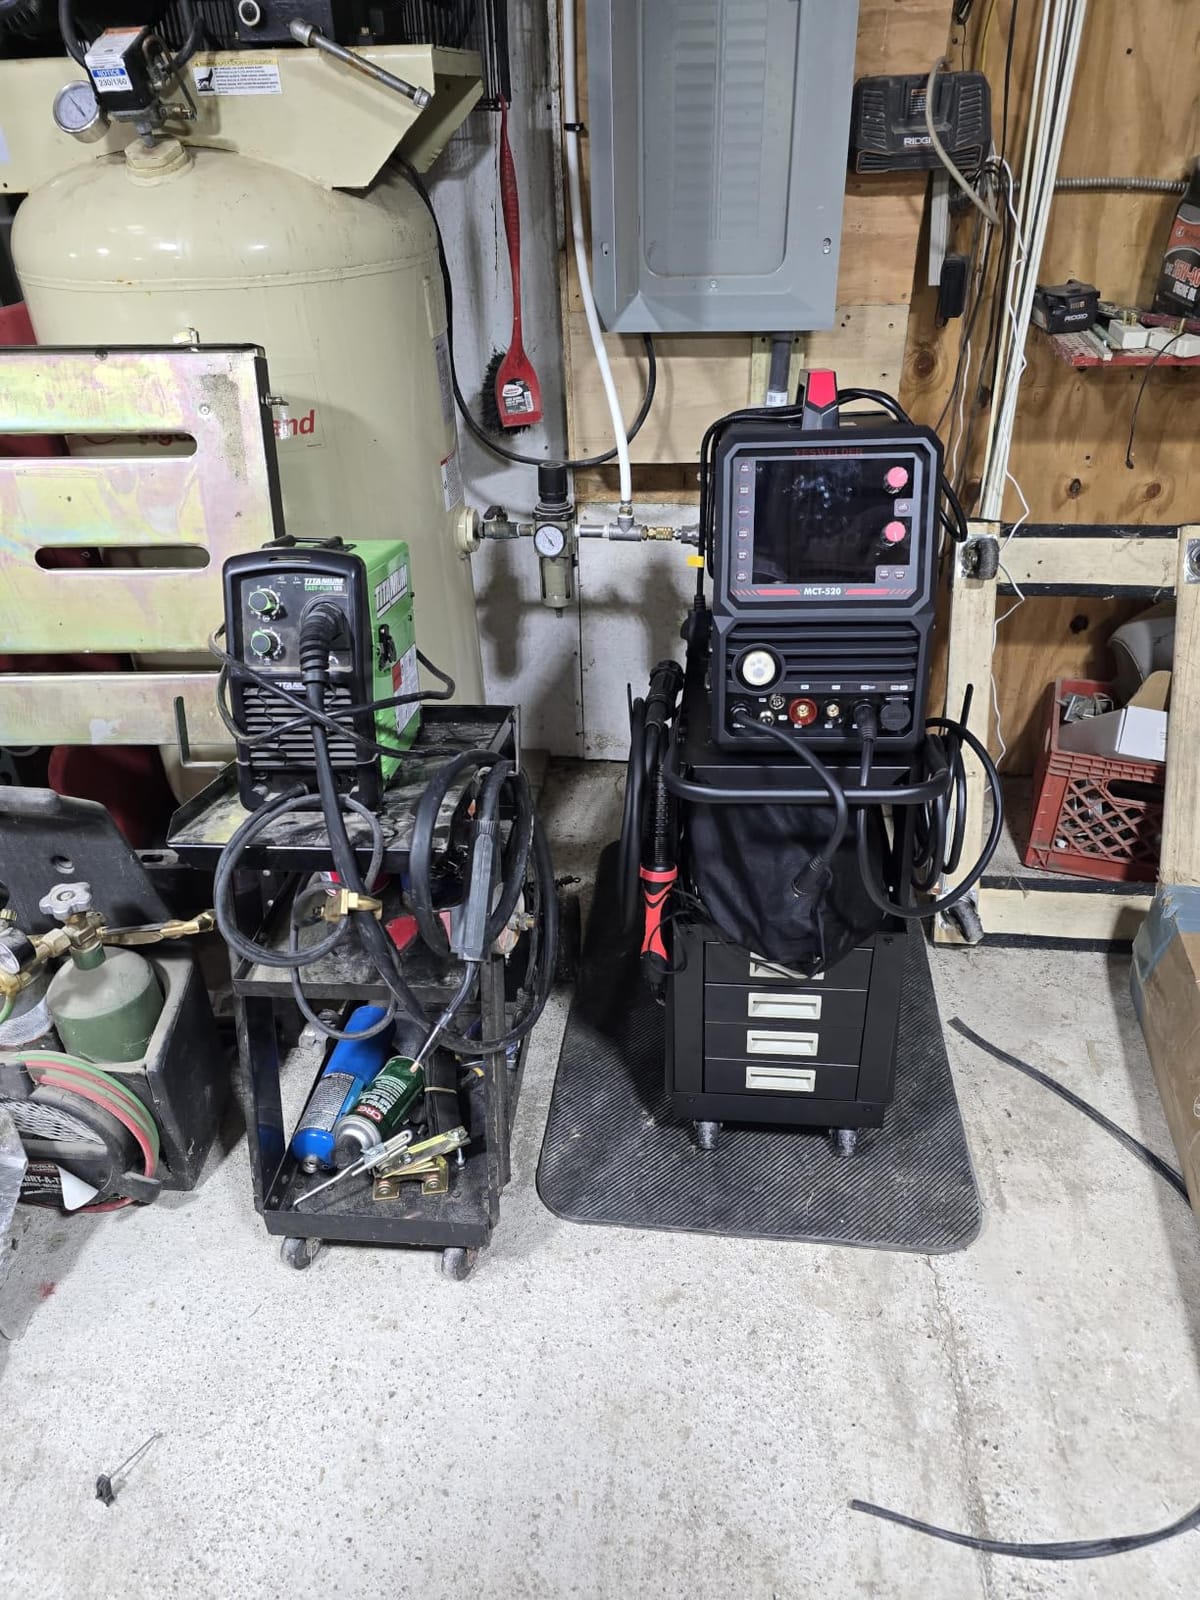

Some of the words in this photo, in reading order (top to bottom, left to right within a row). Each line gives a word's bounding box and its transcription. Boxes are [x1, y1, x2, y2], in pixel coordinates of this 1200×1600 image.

[903, 136, 931, 146] RIDGI
[1064, 313, 1088, 323] RIDGID
[272, 408, 315, 438] and
[304, 577, 345, 585] TITANIUM
[375, 563, 408, 613] TITANIUM
[803, 587, 841, 596] MCT-520
[356, 1105, 382, 1121] CRC
